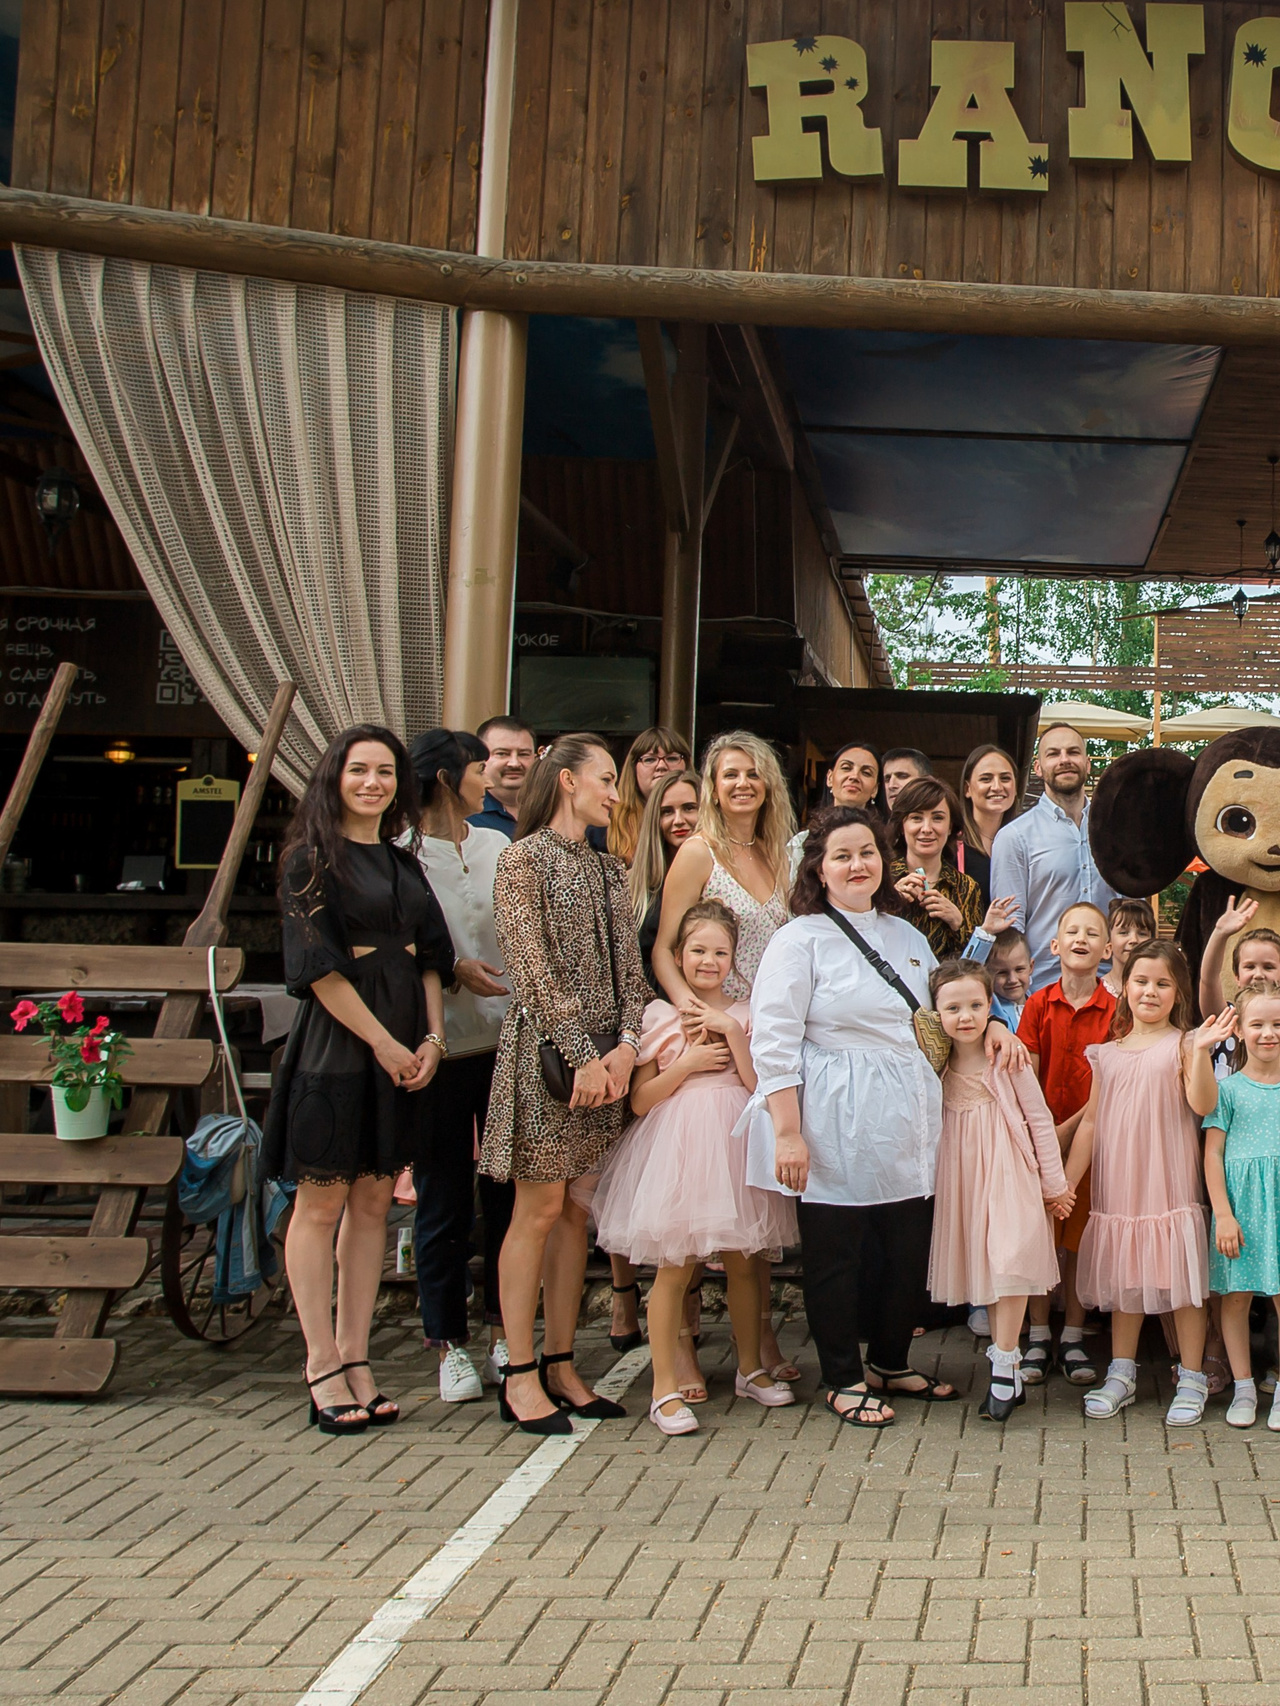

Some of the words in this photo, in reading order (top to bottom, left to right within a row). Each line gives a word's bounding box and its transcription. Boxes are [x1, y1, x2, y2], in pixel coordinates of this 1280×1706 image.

[15, 616, 97, 633] СРОЧНАЯ
[9, 667, 97, 684] СДЕЛТЬ,
[5, 691, 107, 708] ОТДНУТЬ
[192, 787, 223, 795] AMSTEL
